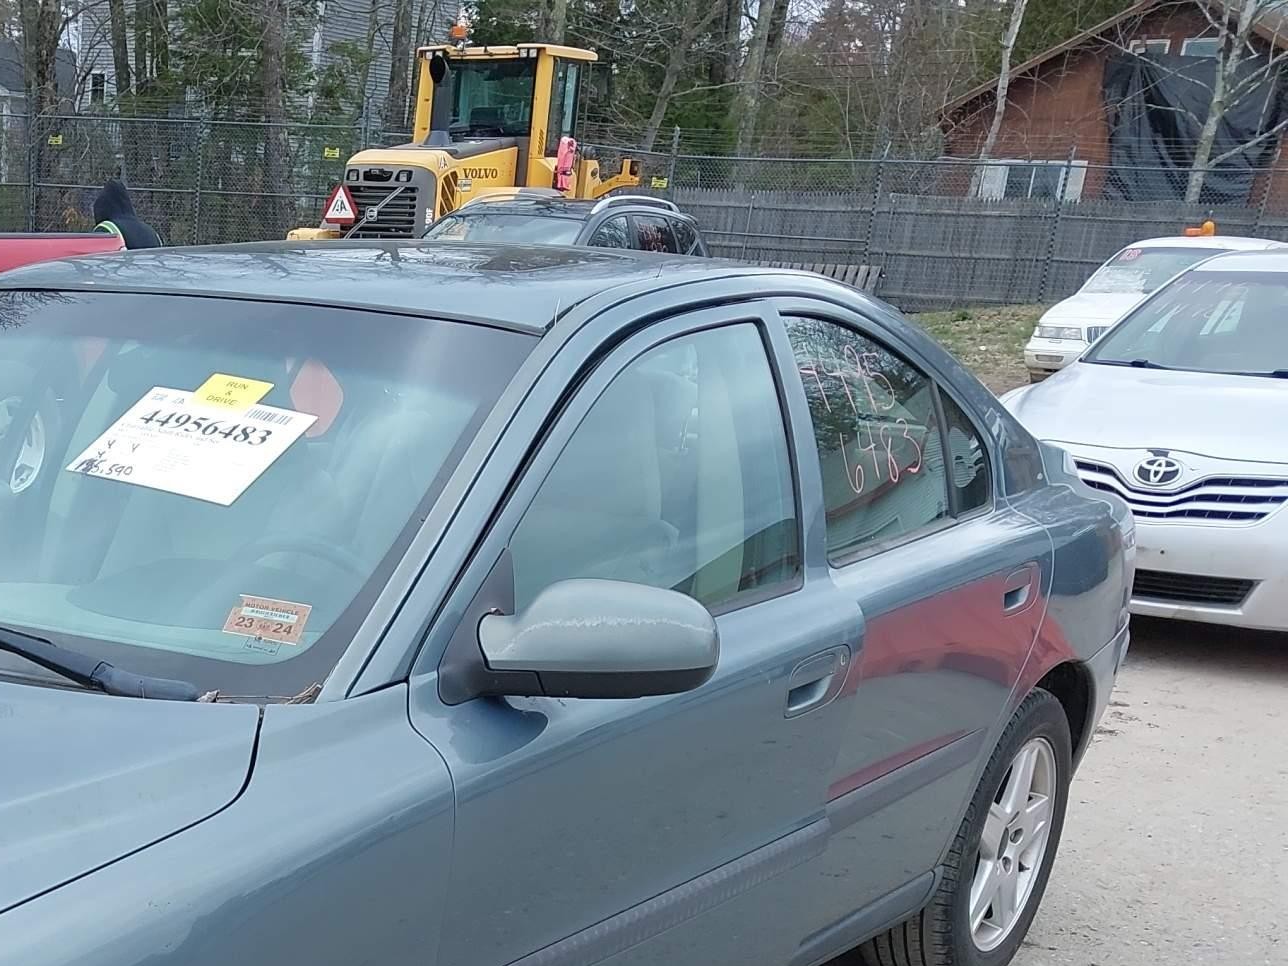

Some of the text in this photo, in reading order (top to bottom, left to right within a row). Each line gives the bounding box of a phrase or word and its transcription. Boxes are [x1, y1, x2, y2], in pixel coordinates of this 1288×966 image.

[462, 167, 498, 179] VOLVO
[226, 381, 249, 390] RUN
[205, 394, 238, 406] DRIVE
[139, 409, 274, 446] 44956483
[838, 417, 923, 494] 6483
[235, 616, 254, 629] 23
[272, 622, 293, 636] 24
